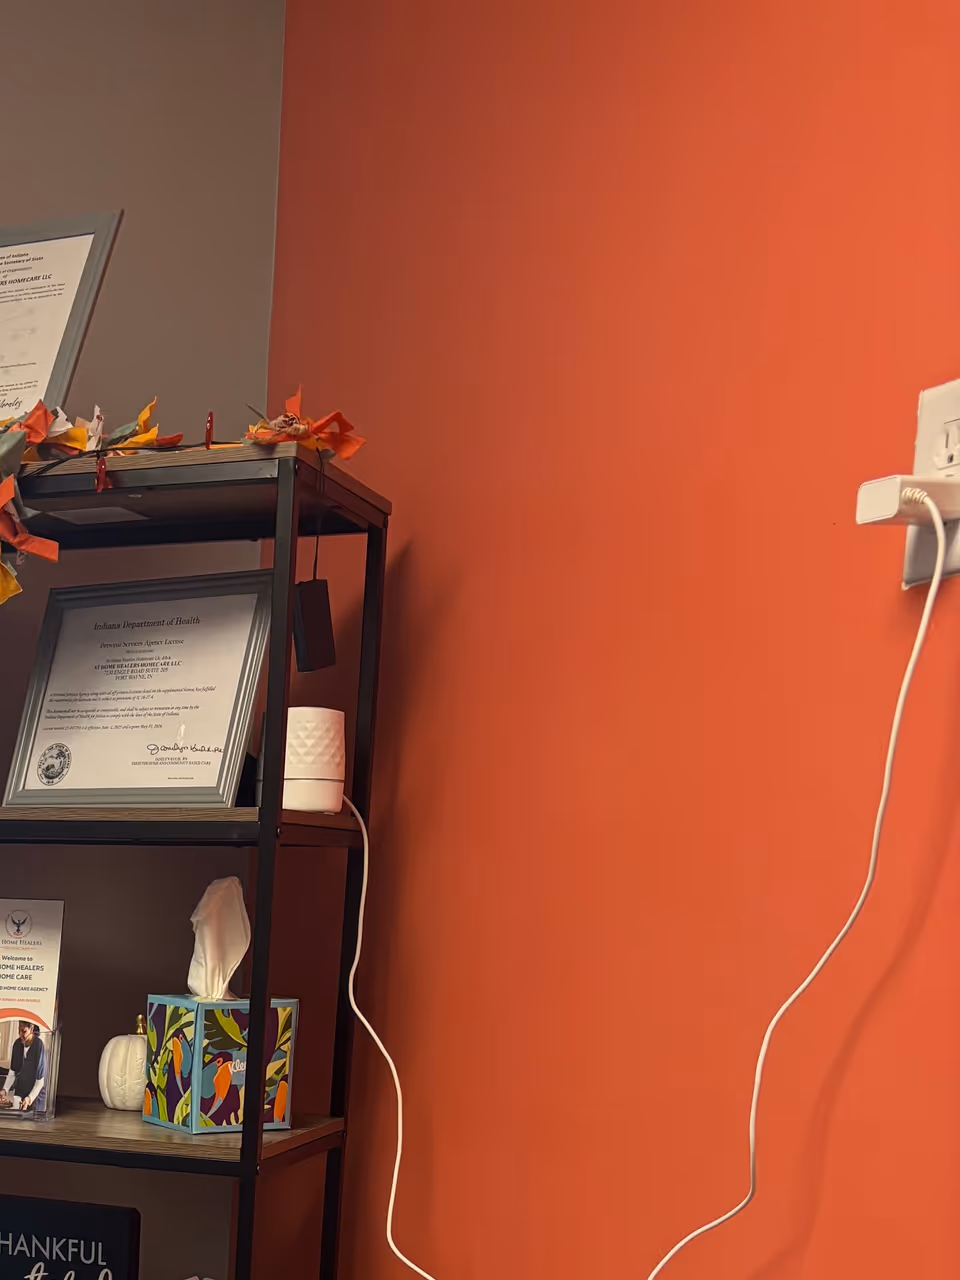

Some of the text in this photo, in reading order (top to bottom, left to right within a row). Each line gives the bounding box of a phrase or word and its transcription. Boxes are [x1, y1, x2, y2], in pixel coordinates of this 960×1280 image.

[8, 275, 41, 285] HOMECARE
[122, 619, 165, 630] Department
[166, 617, 174, 626] of
[175, 616, 201, 625] Health
